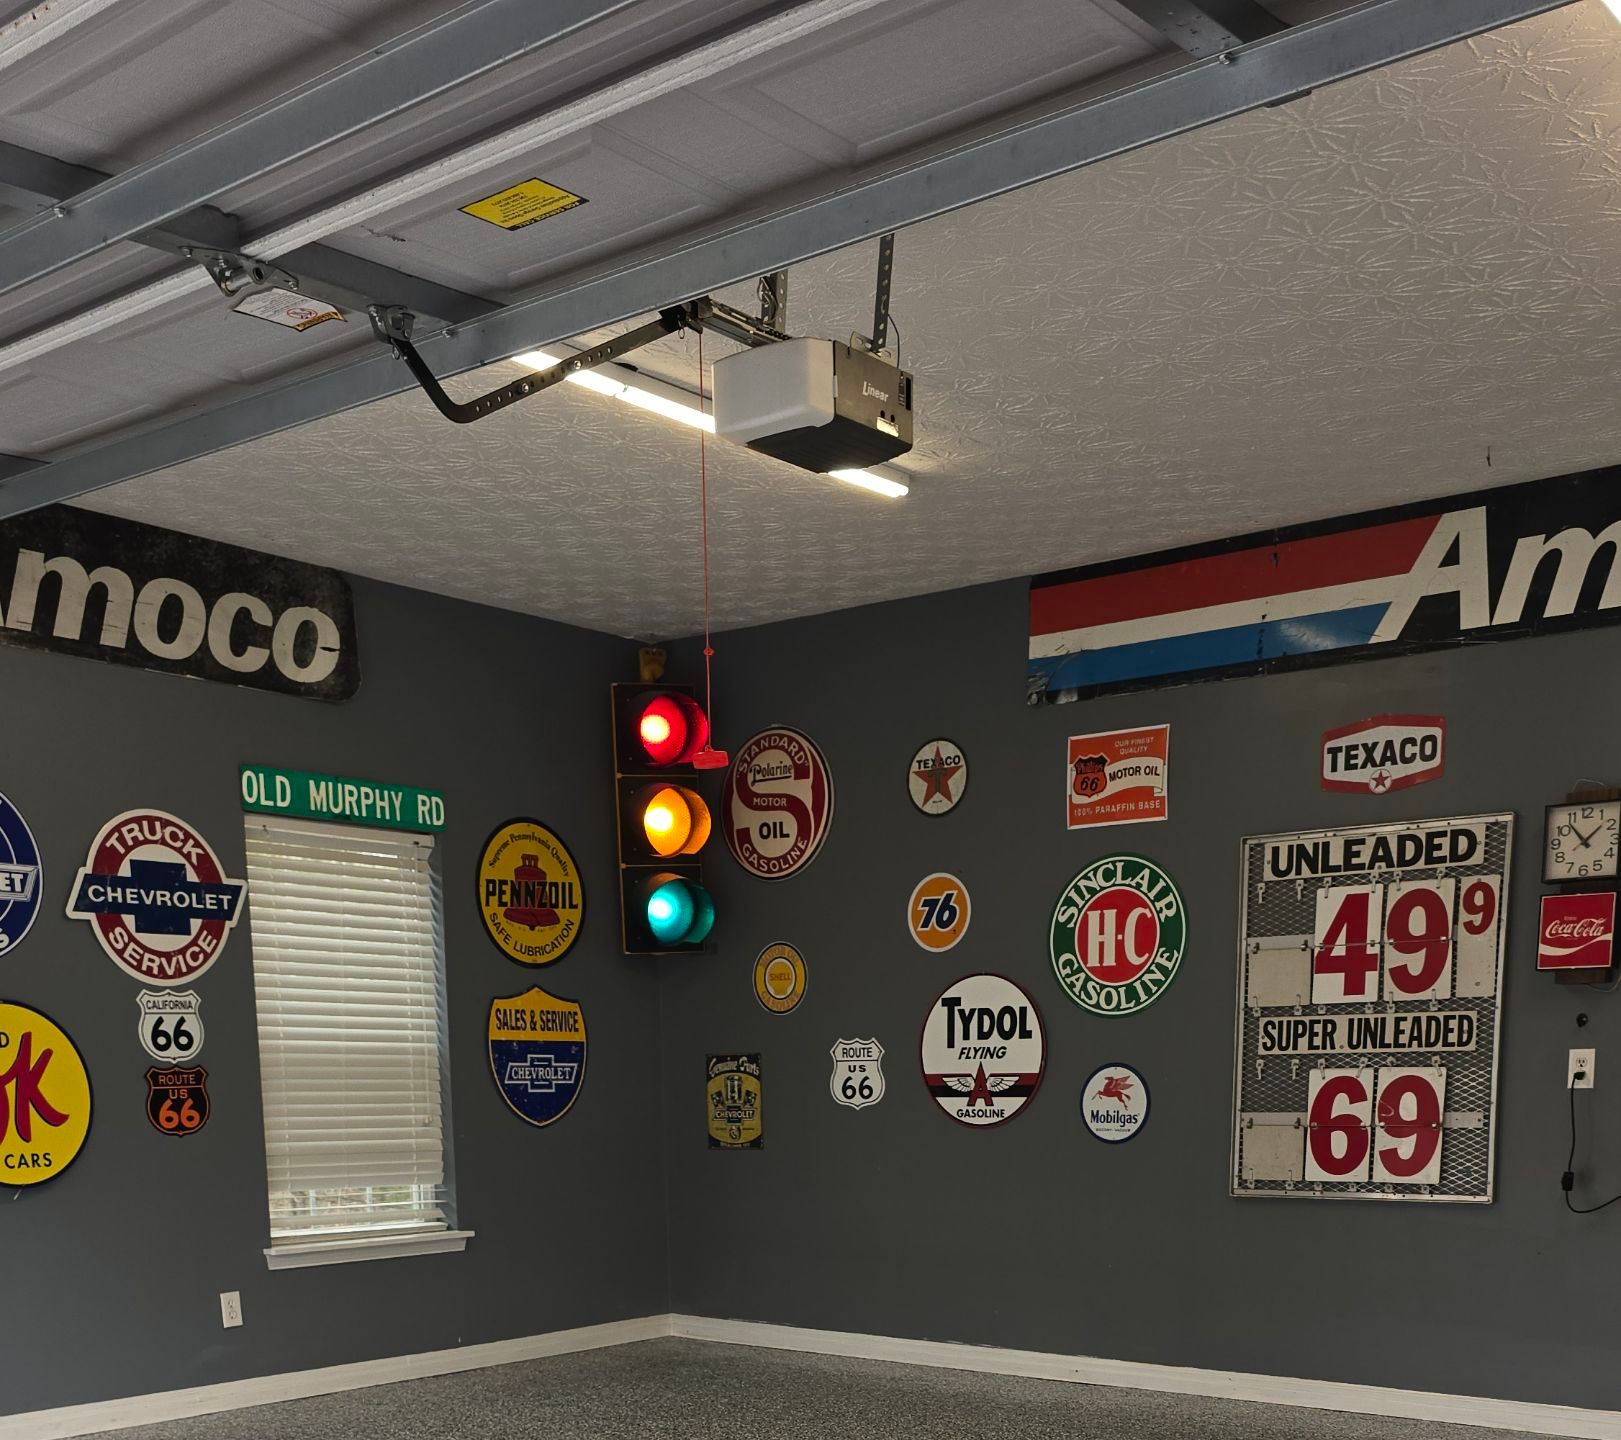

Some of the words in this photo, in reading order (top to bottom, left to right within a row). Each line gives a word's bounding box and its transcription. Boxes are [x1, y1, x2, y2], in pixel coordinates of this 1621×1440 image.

[862, 380, 889, 402] Linear
[0, 547, 340, 683] moco
[1119, 746, 1148, 755] QUALITY
[1327, 734, 1438, 773] TEXACO
[916, 754, 961, 770] TEXACO
[750, 760, 793, 786] Polarine
[1108, 765, 1142, 782] MOTOR
[1144, 765, 1160, 776] OIL
[1080, 776, 1100, 792] 66
[241, 770, 292, 808] OLD
[308, 779, 403, 822] MURPHY
[417, 794, 445, 826] RD
[753, 796, 787, 807] MOTOR
[1095, 803, 1135, 815] PARAFFIN
[1138, 800, 1161, 809] BASE
[1582, 806, 1595, 819] 12
[1599, 808, 1605, 820] 1
[1568, 811, 1577, 823] 11
[1606, 818, 1617, 831] 2
[758, 821, 790, 840] OIL
[1557, 824, 1571, 837] 10
[105, 820, 205, 866] TRUCK
[1551, 838, 1561, 851] 9
[742, 838, 808, 872] GASOLINE
[1270, 828, 1478, 879] UNLEADED
[1554, 851, 1566, 863] 8
[1603, 846, 1616, 859] 4
[1565, 861, 1575, 874] 7
[1578, 864, 1589, 877] 6
[1592, 859, 1604, 872] 5
[87, 884, 233, 911] CHEVROLET
[484, 878, 579, 910] PENNZOIL
[1057, 861, 1177, 928] SINCLAIR
[916, 889, 960, 932] 76
[489, 912, 513, 946] SAFE
[512, 918, 576, 957] LUBRICATION
[1545, 916, 1607, 939] Coca-Cola
[108, 926, 218, 977] SERVICE
[1058, 947, 1179, 1010] GASOLINE
[145, 1000, 194, 1010] CALIFORNIA
[495, 1008, 527, 1030] SALES
[529, 1010, 537, 1031] &
[539, 1010, 579, 1033] SERVICE
[941, 996, 1033, 1049] TYDOL
[151, 1016, 194, 1052] 66
[1262, 1018, 1338, 1051] SUPER
[1347, 1014, 1475, 1050] UNLEADED
[842, 1047, 873, 1058] ROUTE
[958, 1046, 1007, 1060] FLYING
[511, 1067, 572, 1079] CHEVROLET
[848, 1064, 866, 1073] US
[158, 1074, 196, 1085] ROUTE
[841, 1076, 873, 1100] 66
[169, 1088, 188, 1099] US
[159, 1098, 200, 1129] 66
[956, 1108, 1006, 1118] GASOLINE
[1090, 1109, 1138, 1127] Mobilgas
[1309, 1075, 1441, 1178] 69
[4, 1152, 53, 1170] CARS
